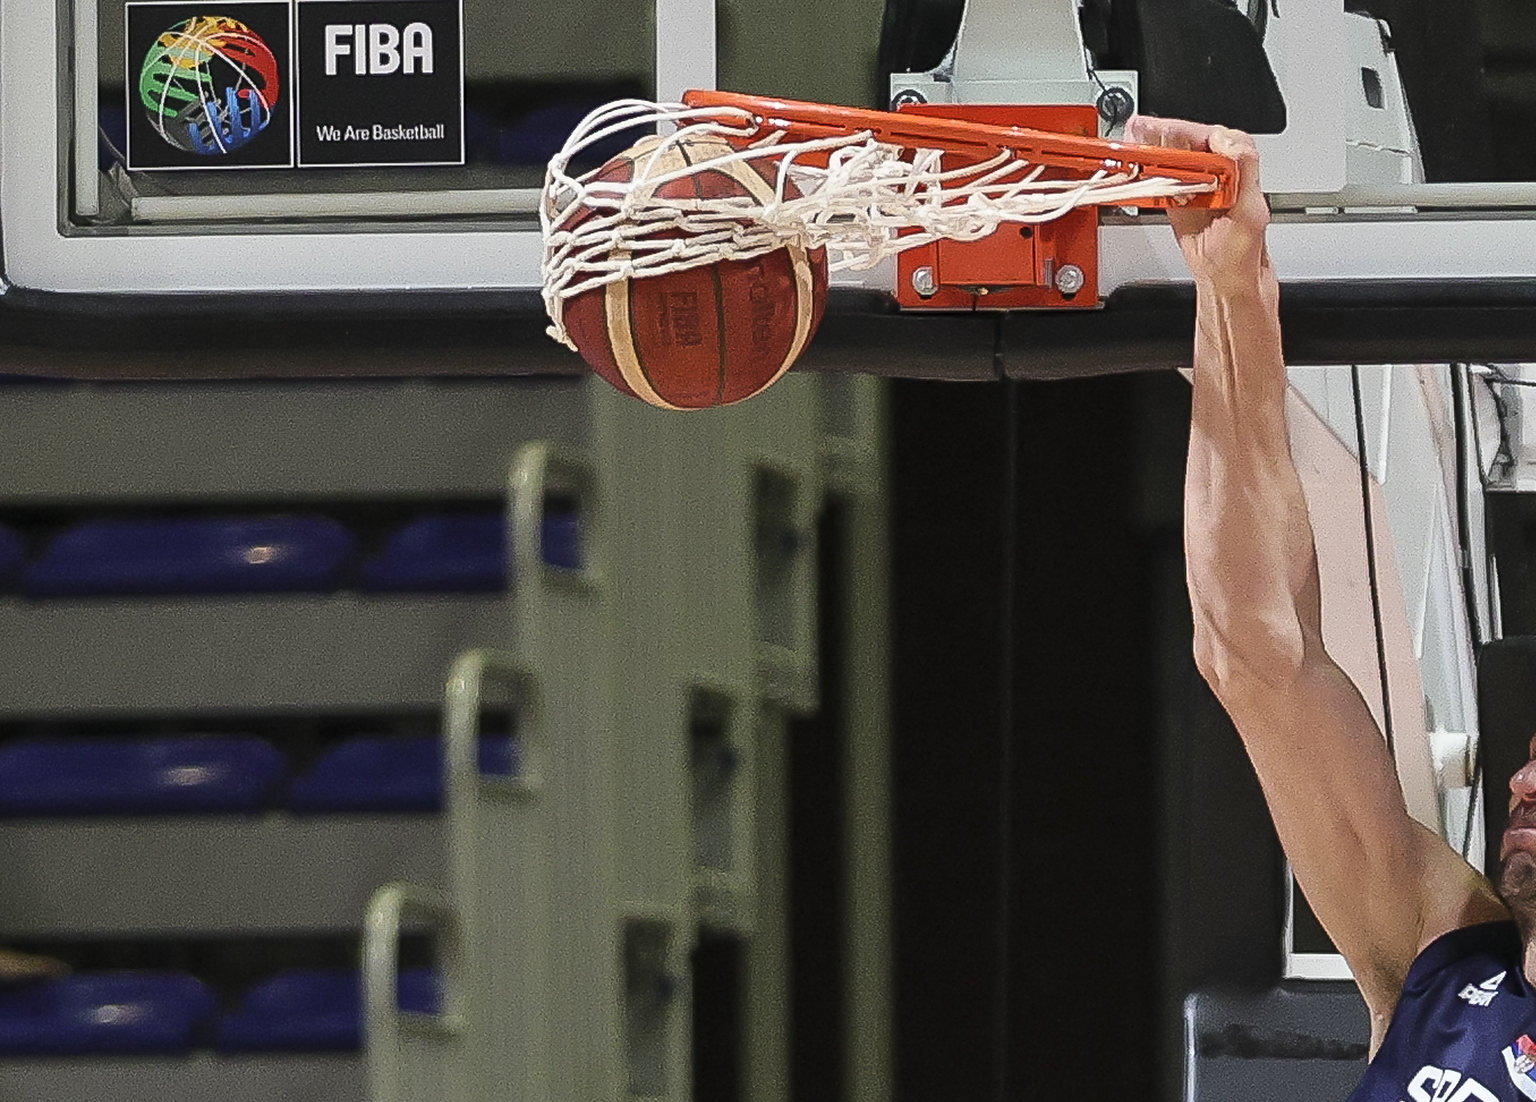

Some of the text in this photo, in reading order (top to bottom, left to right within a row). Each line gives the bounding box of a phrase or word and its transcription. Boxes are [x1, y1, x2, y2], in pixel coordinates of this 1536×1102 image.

[324, 22, 434, 76] FIBA
[316, 123, 445, 142] We Are Basketball
